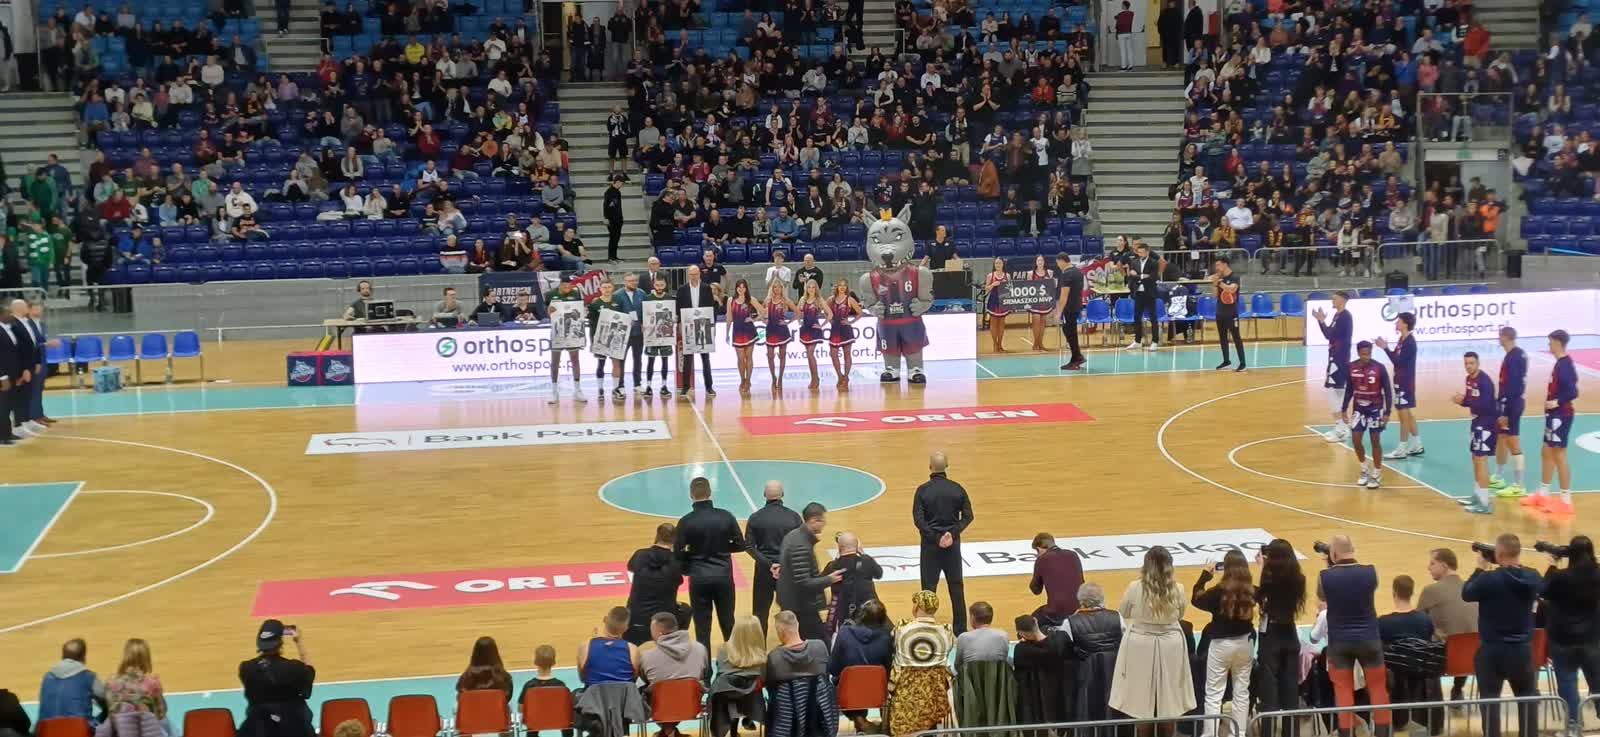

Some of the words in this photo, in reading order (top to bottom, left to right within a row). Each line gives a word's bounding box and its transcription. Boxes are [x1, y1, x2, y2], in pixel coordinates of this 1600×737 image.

[904, 280, 912, 292] 6
[1009, 286, 1036, 297] 1000
[463, 335, 551, 356] orthosp
[1368, 376, 1376, 384] 3
[880, 410, 1040, 424] ORLEN
[424, 432, 525, 444] Bank
[536, 428, 657, 438] Pekao
[977, 547, 1112, 565] Bak
